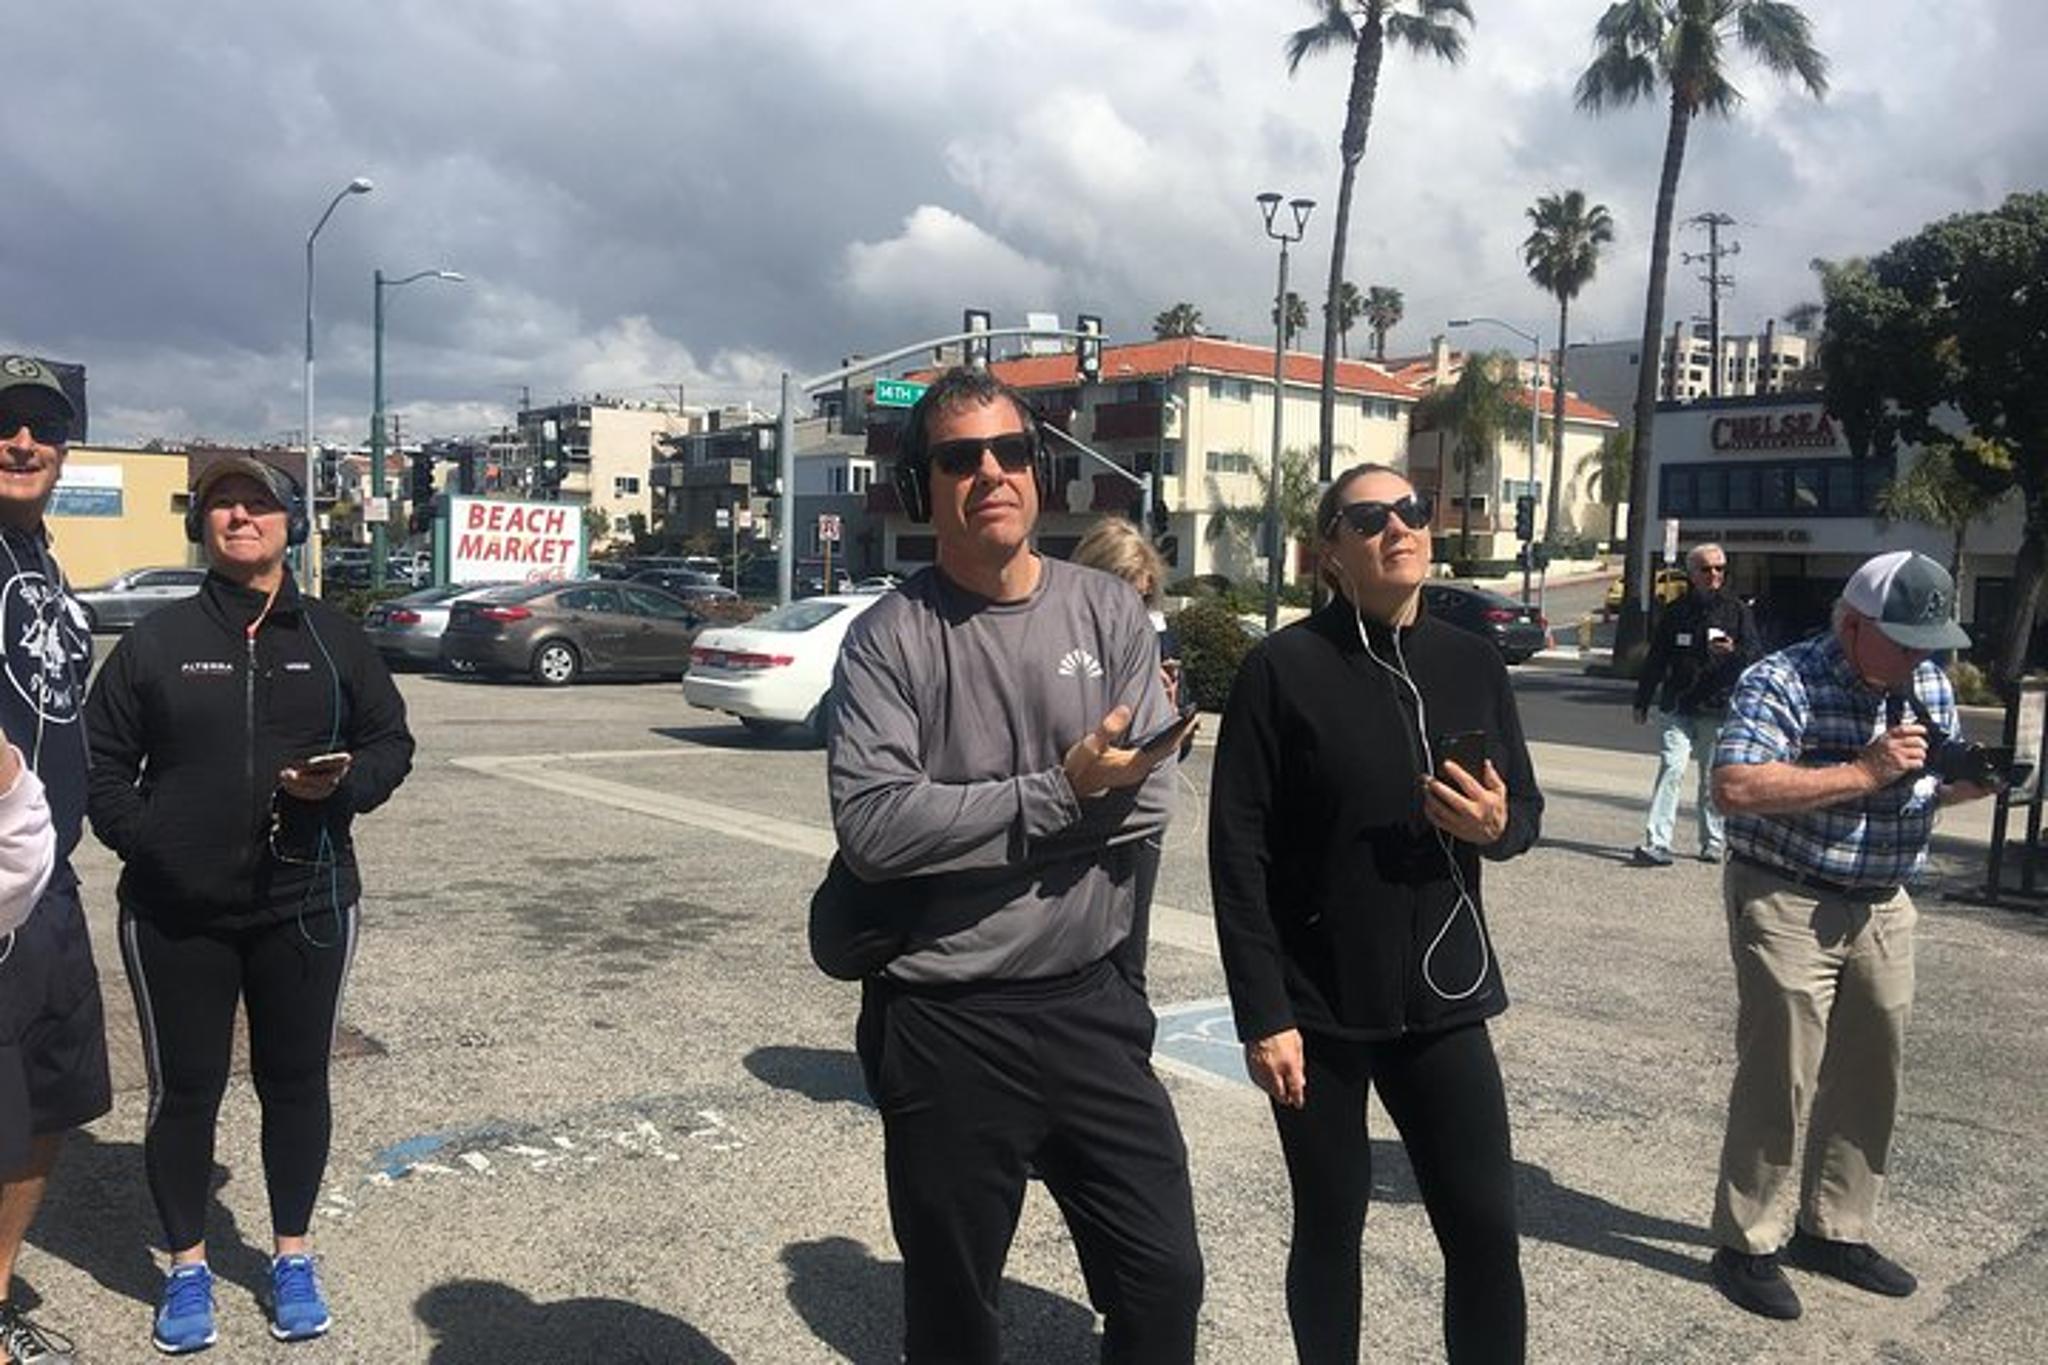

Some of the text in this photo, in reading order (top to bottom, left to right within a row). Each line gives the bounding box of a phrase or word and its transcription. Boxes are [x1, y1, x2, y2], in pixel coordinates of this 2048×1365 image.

[1711, 411, 1835, 449] CHELSEA
[467, 502, 566, 534] BEACH
[456, 534, 575, 563] MARKET
